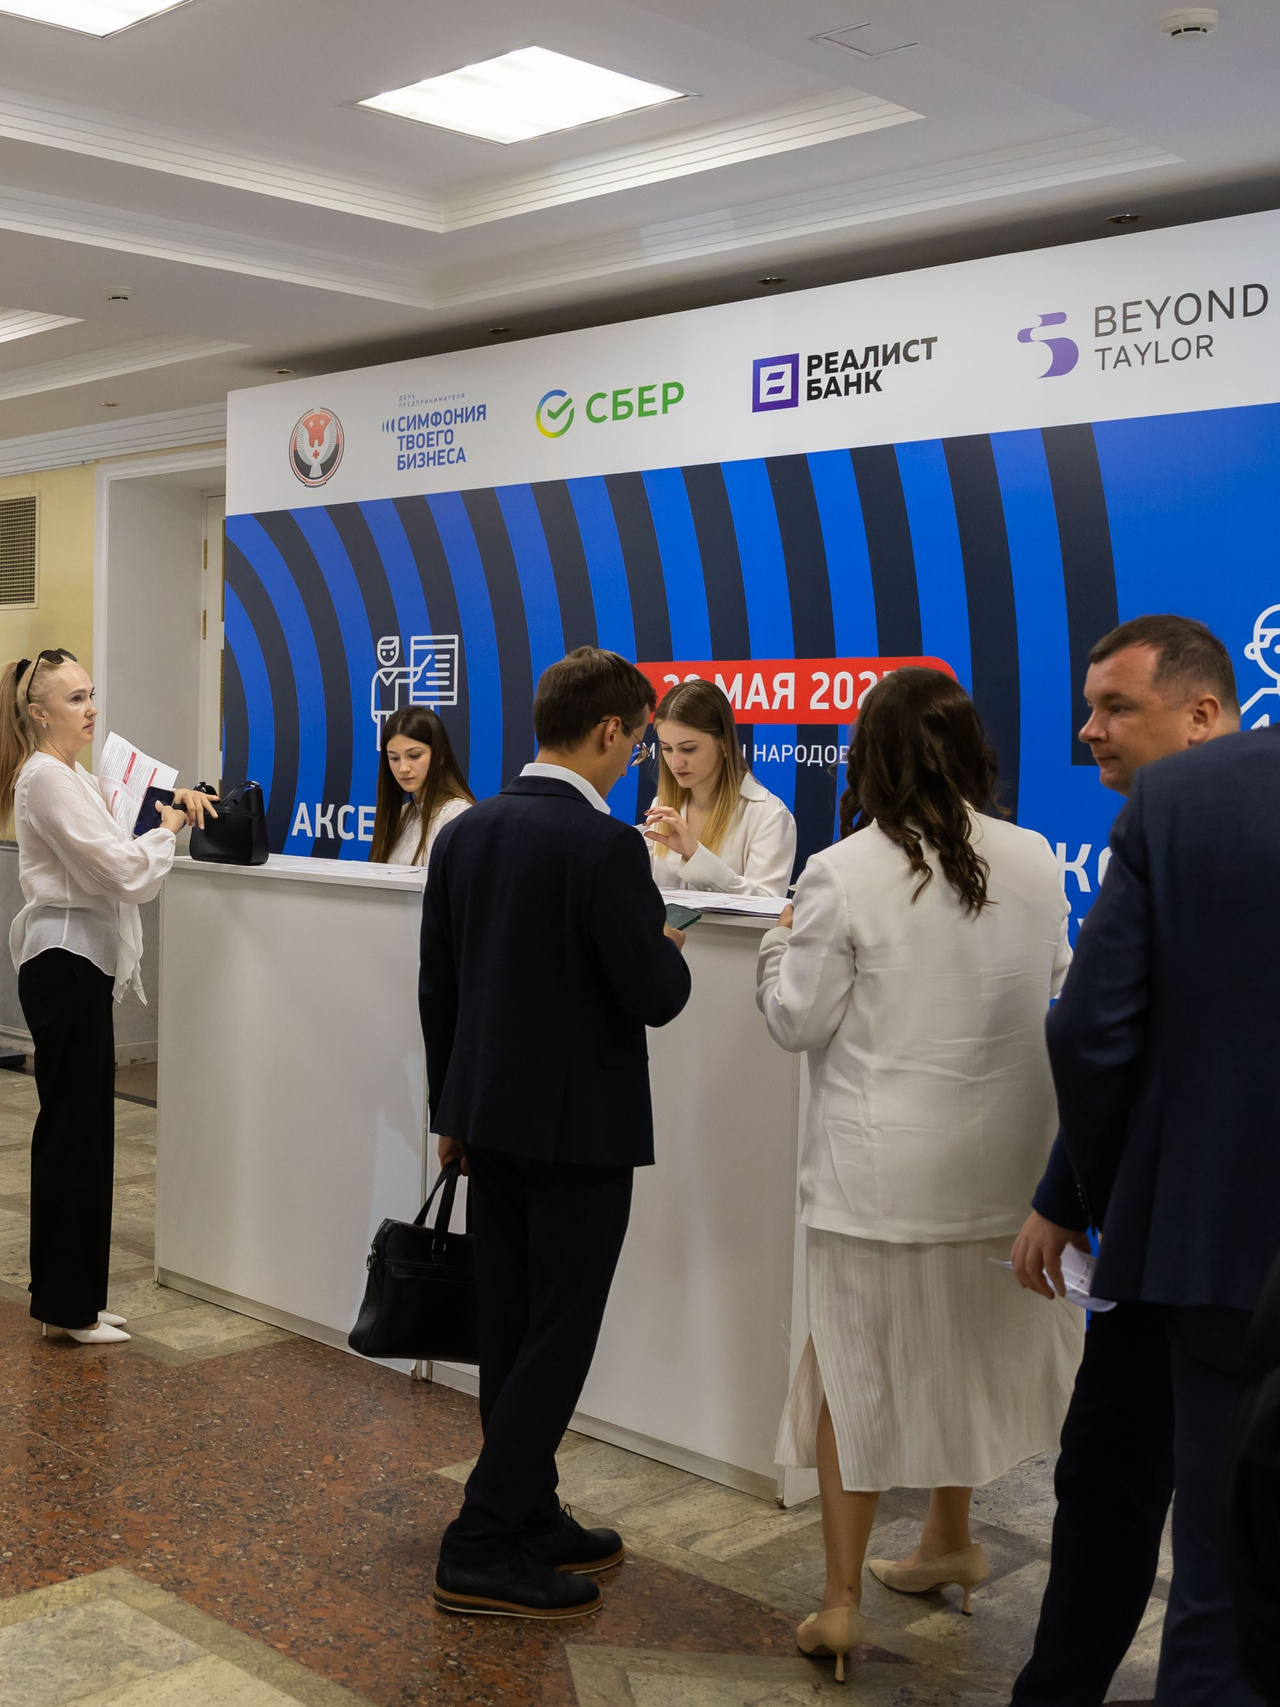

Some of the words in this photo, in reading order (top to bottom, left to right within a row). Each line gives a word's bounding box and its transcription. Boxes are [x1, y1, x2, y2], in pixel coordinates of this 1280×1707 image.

[1094, 283, 1269, 338] BEYOND
[806, 336, 938, 377] РЕАЛИСТ
[1094, 334, 1214, 371] TAYLOR
[399, 393, 416, 401] ДЕНЬ
[585, 381, 685, 424] СБЕР
[806, 369, 883, 401] БАНК
[397, 404, 487, 432] СИМФОНИЯ
[397, 428, 454, 451] ТВОЕГО
[397, 446, 467, 471] БИЗНЕСА
[715, 672, 795, 710] МАЯ
[809, 670, 898, 710] 202
[291, 802, 377, 842] АКСЕ
